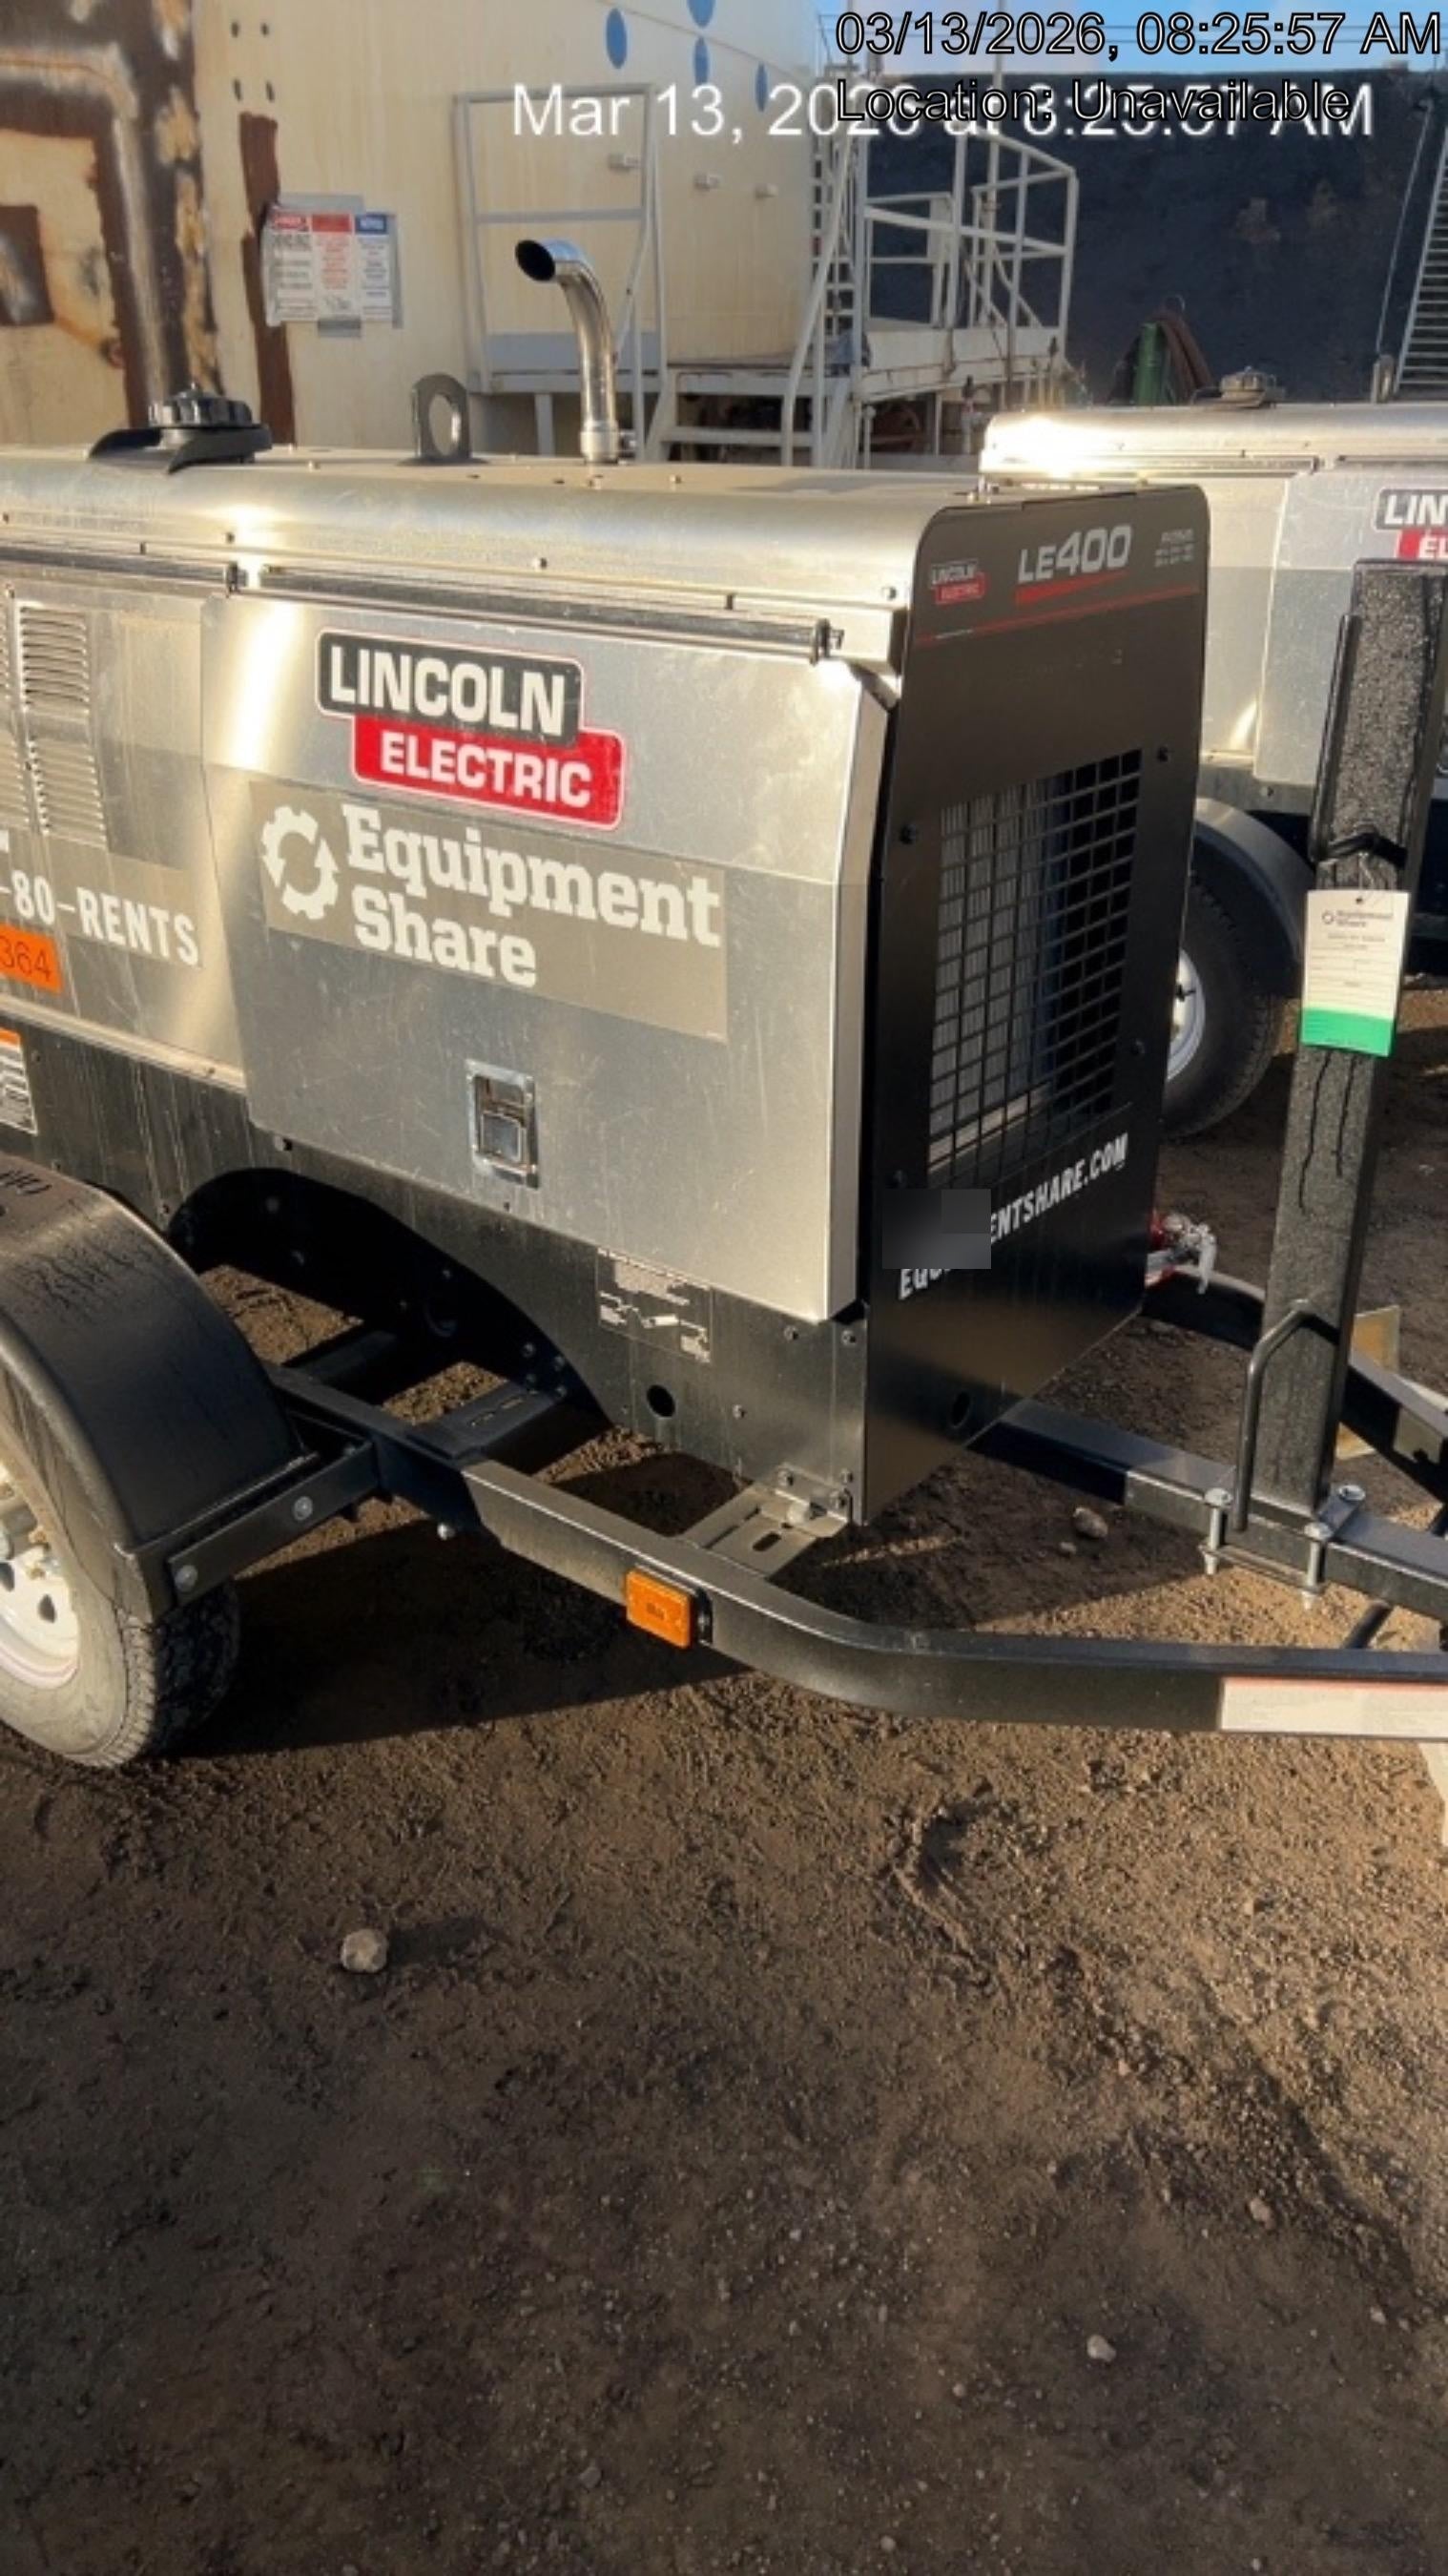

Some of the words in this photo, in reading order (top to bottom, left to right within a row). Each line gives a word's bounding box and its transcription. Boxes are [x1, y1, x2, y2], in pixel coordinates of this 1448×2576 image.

[1018, 525, 1133, 584] LE400
[330, 645, 565, 737] LINCOLN
[381, 731, 592, 809] ELECTRIC
[341, 802, 722, 948] Equipment
[351, 883, 538, 988] Share
